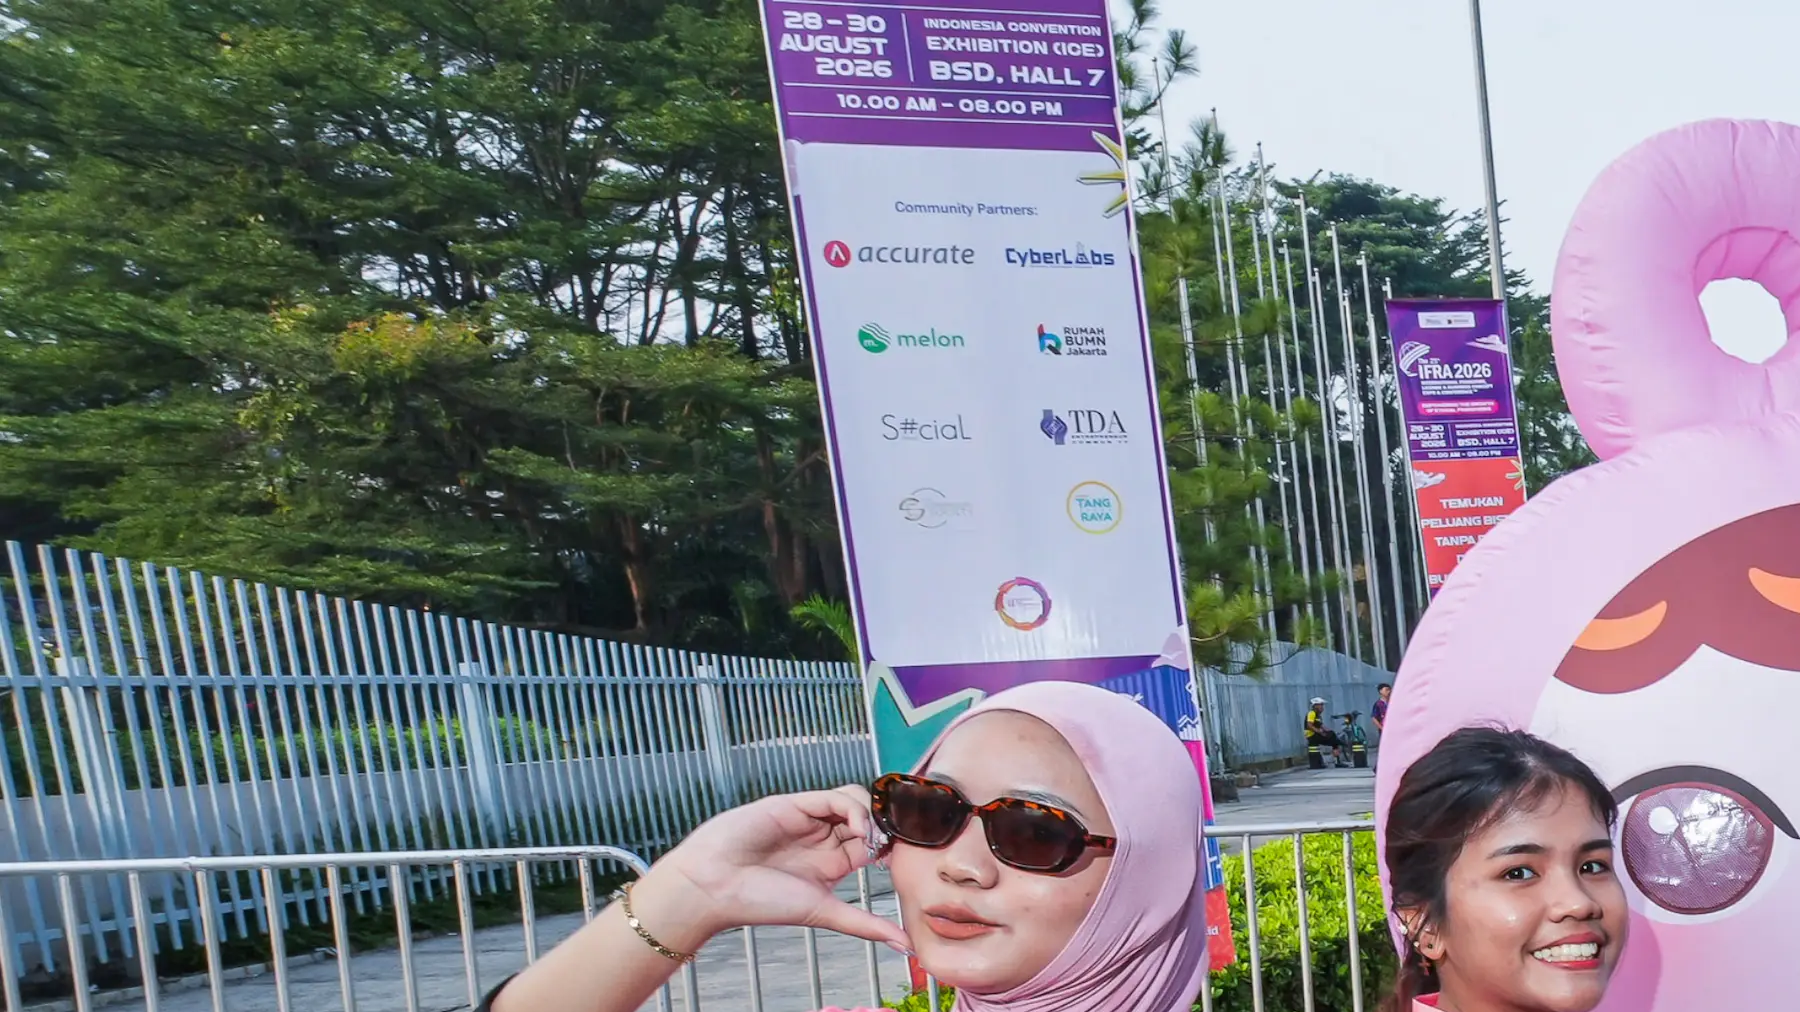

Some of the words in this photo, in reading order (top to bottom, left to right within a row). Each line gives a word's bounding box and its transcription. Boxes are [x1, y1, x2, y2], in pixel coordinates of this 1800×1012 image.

[783, 10, 823, 30] 28
[846, 14, 887, 33] 30
[923, 18, 1006, 32] INDONESIA
[1007, 22, 1102, 36] CONVENTION
[780, 33, 888, 55] AUGUST
[925, 36, 1049, 55] EXHIBITION
[1052, 42, 1105, 58] (ICE)
[814, 57, 893, 78] 2026
[929, 60, 1005, 84] BSD,
[1010, 65, 1082, 86] HALL
[1087, 68, 1106, 87] 7
[836, 93, 900, 110] 10.00
[905, 96, 937, 111] AM
[959, 98, 1027, 115] 08.00
[1030, 101, 1063, 116] PM
[895, 201, 973, 217] Community
[977, 203, 1038, 216] Partners:
[858, 243, 975, 265] accurate
[897, 327, 965, 347] melon
[1063, 327, 1105, 335] RUMAH
[1065, 336, 1106, 346] BUMN
[1066, 347, 1107, 356] Jakarta
[1418, 364, 1453, 379] IFRA
[1453, 363, 1492, 379] 2026
[1068, 410, 1127, 434] TDA
[1483, 438, 1507, 446] HALL
[1508, 437, 1515, 445] 7
[1075, 498, 1112, 508] TANG
[1439, 496, 1504, 509] TEMUKAN
[1080, 512, 1113, 522] RAYA
[1421, 516, 1482, 528] PELUANG
[1434, 535, 1476, 547] TANPA
